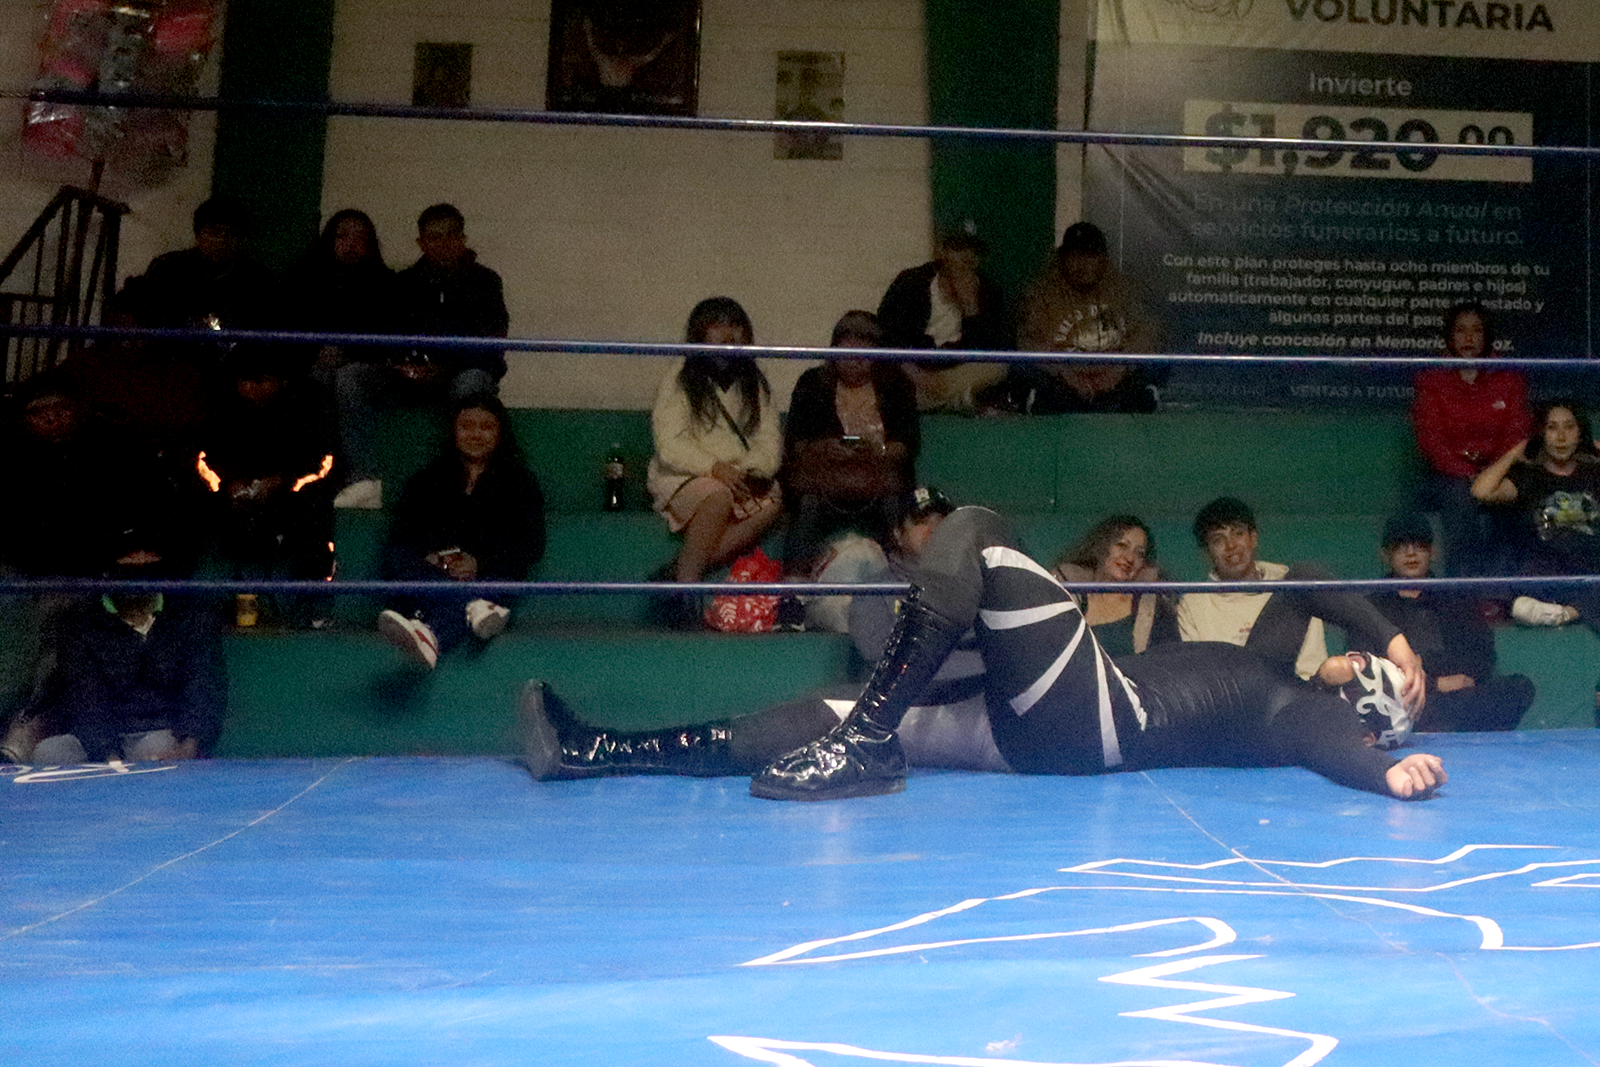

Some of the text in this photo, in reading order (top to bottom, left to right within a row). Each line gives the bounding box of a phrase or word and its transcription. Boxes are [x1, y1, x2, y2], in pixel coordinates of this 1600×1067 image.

[1310, 72, 1412, 97] Invierte
[1300, 221, 1421, 243] funerarios
[1427, 229, 1440, 243] a
[1163, 253, 1550, 277] Con este plan proteges hasta ocho miembros de tu
[1186, 272, 1240, 286] familia
[1418, 279, 1470, 293] padres
[1473, 282, 1484, 292] e
[1311, 295, 1331, 307] en
[1334, 294, 1406, 310] cualquier
[1410, 296, 1450, 310] parte
[1535, 300, 1545, 313] y
[1269, 310, 1330, 326] algunas
[1333, 312, 1382, 327] partes
[1385, 312, 1410, 326] del
[1197, 332, 1260, 348] Incluye
[1262, 333, 1346, 348] concesión
[1351, 336, 1371, 348] en
[1375, 335, 1446, 350] Memoria
[1366, 385, 1416, 399] FUTUR
